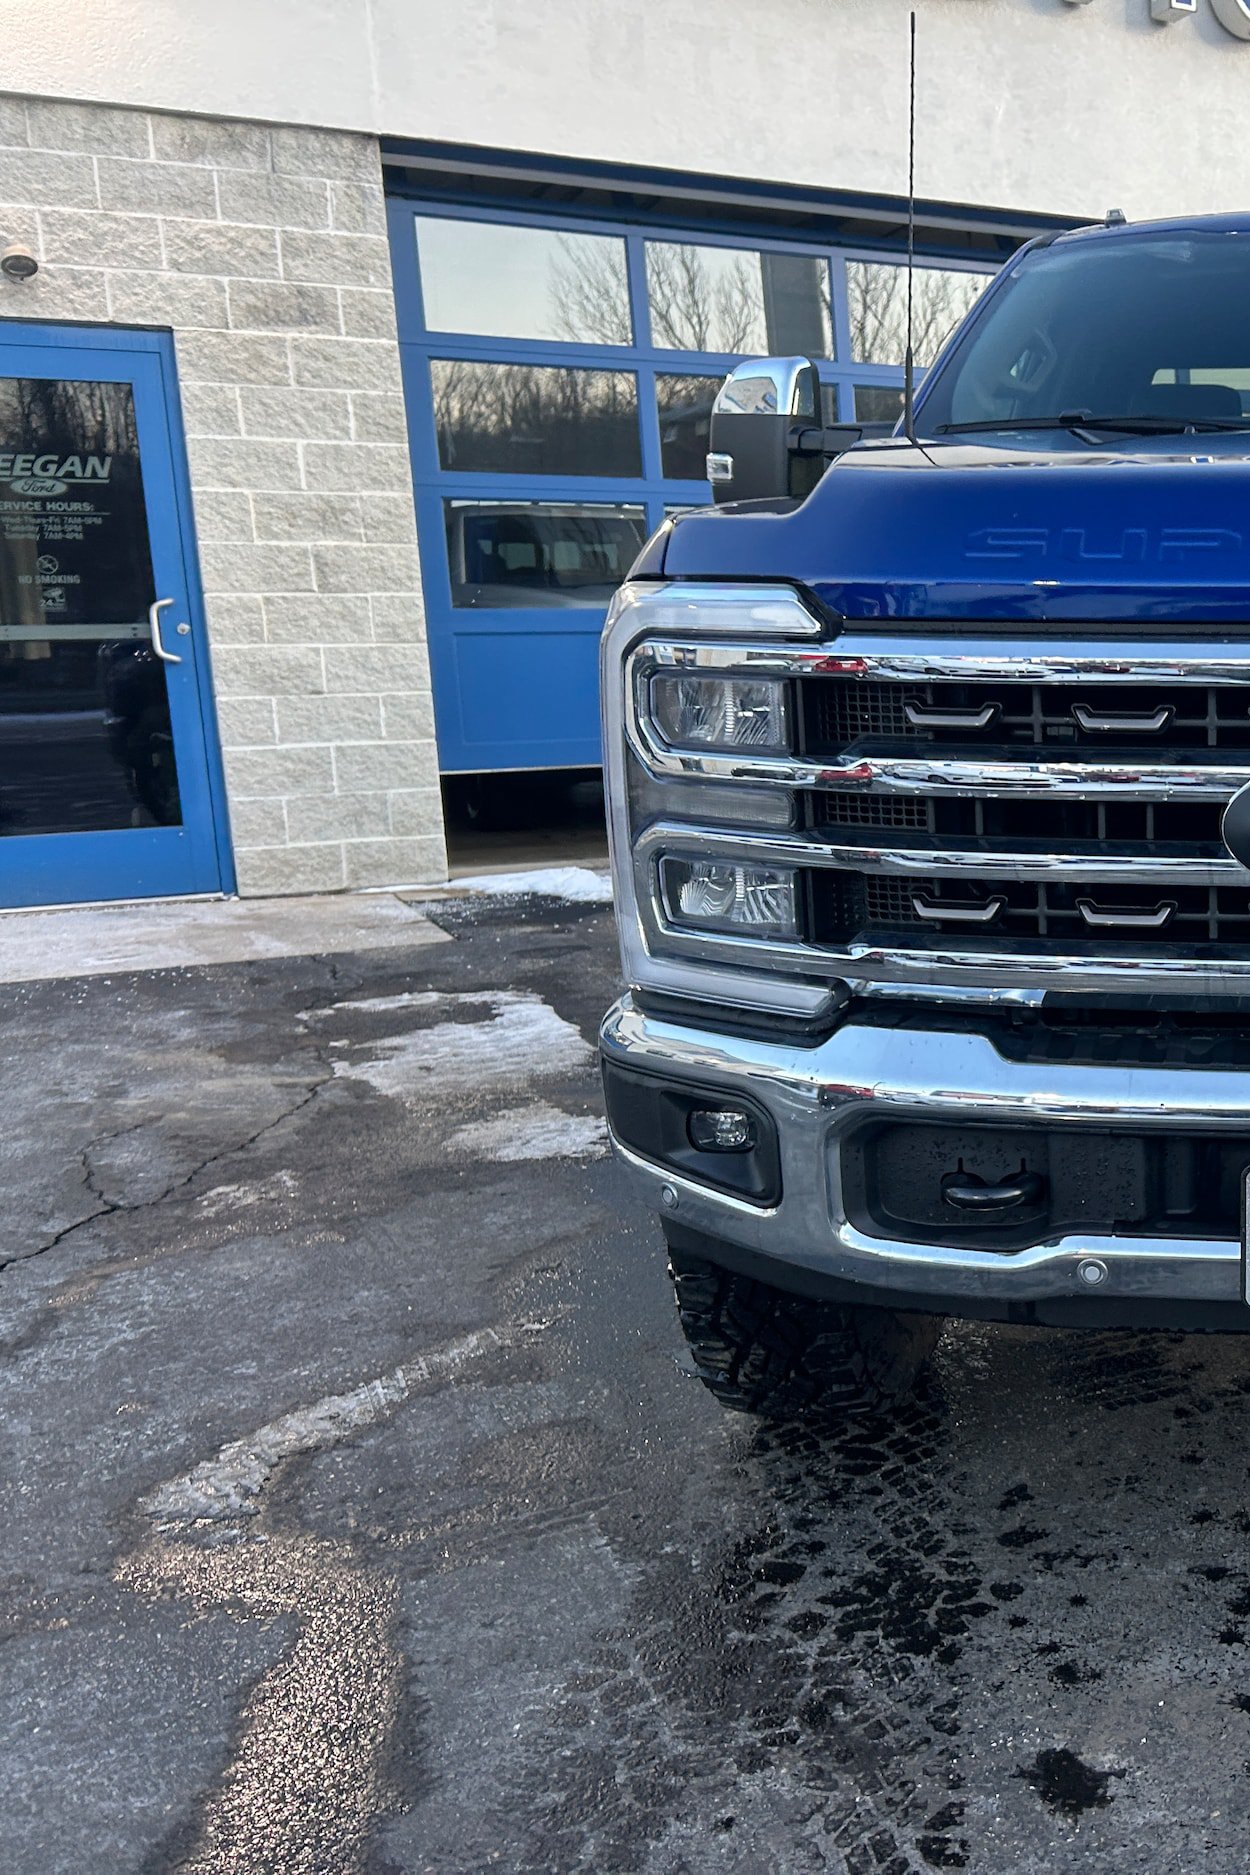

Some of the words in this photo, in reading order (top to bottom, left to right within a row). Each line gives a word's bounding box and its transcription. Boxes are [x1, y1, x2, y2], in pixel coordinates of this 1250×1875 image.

[21, 478, 57, 493] Ford
[18, 575, 33, 584] NO
[34, 574, 81, 584] SMOKING
